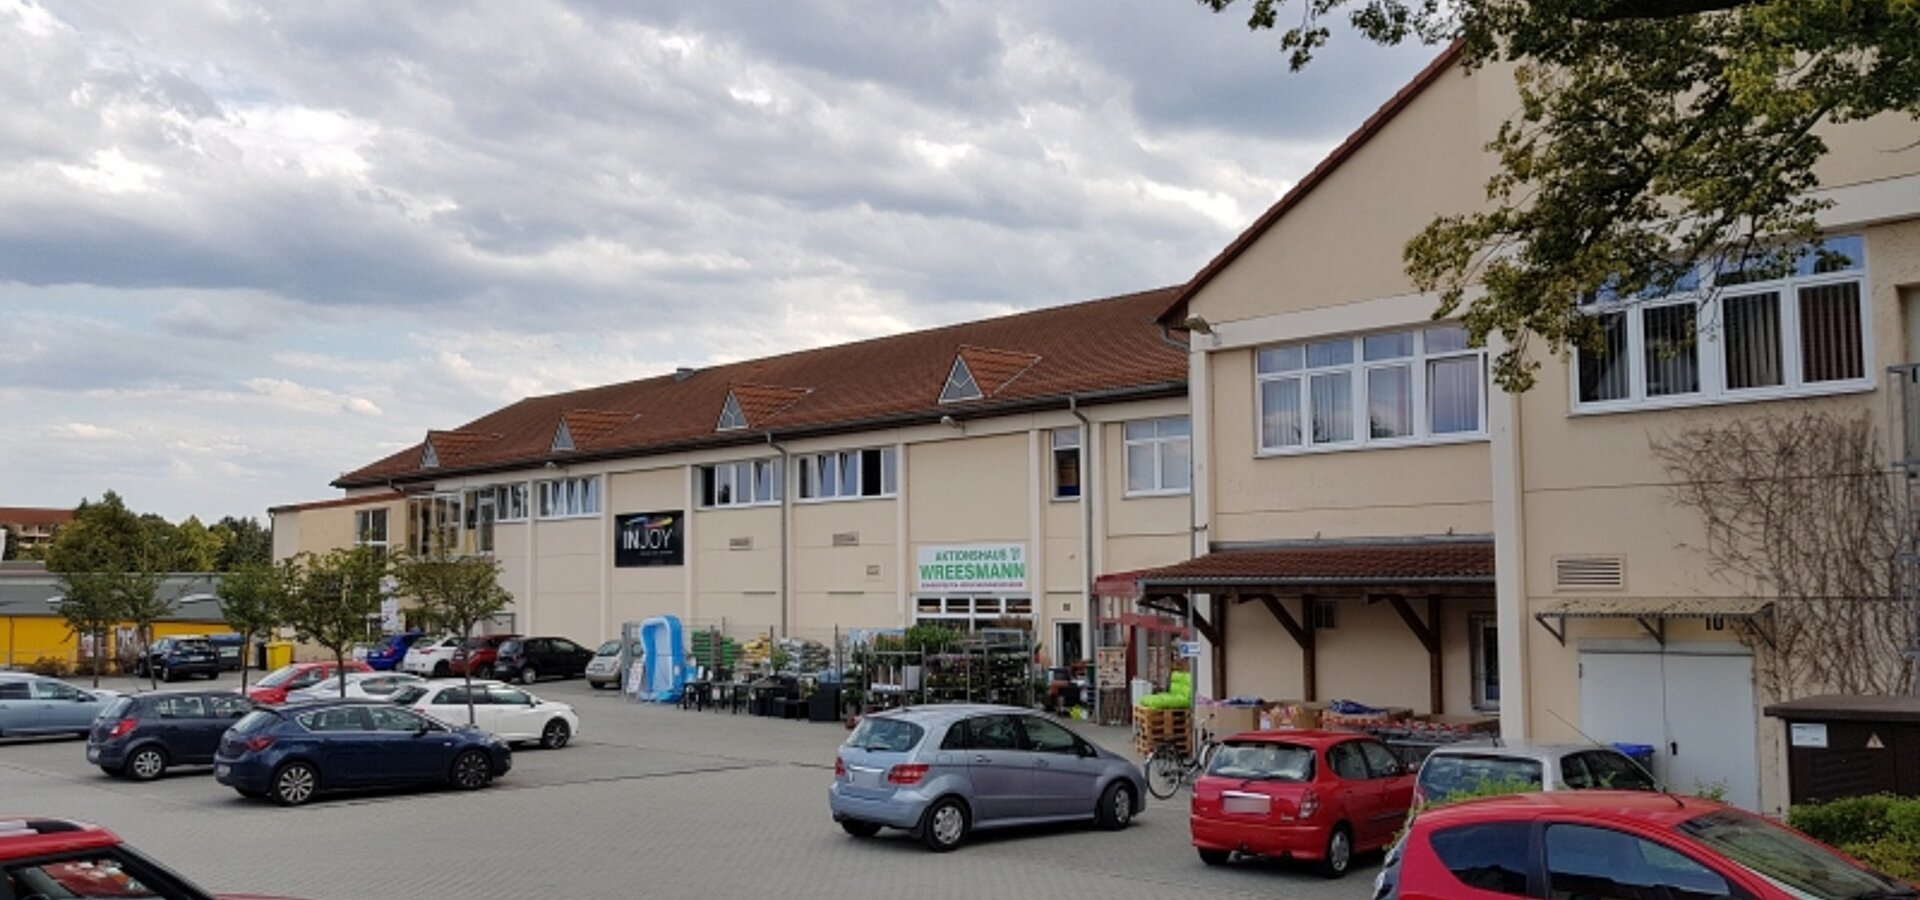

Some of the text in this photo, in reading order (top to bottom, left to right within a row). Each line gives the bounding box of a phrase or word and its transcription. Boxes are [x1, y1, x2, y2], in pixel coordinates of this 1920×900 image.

[623, 528, 673, 550] INJOY
[935, 548, 1008, 561] AKTIONSHAUS
[919, 562, 1026, 580] WREESMANN
